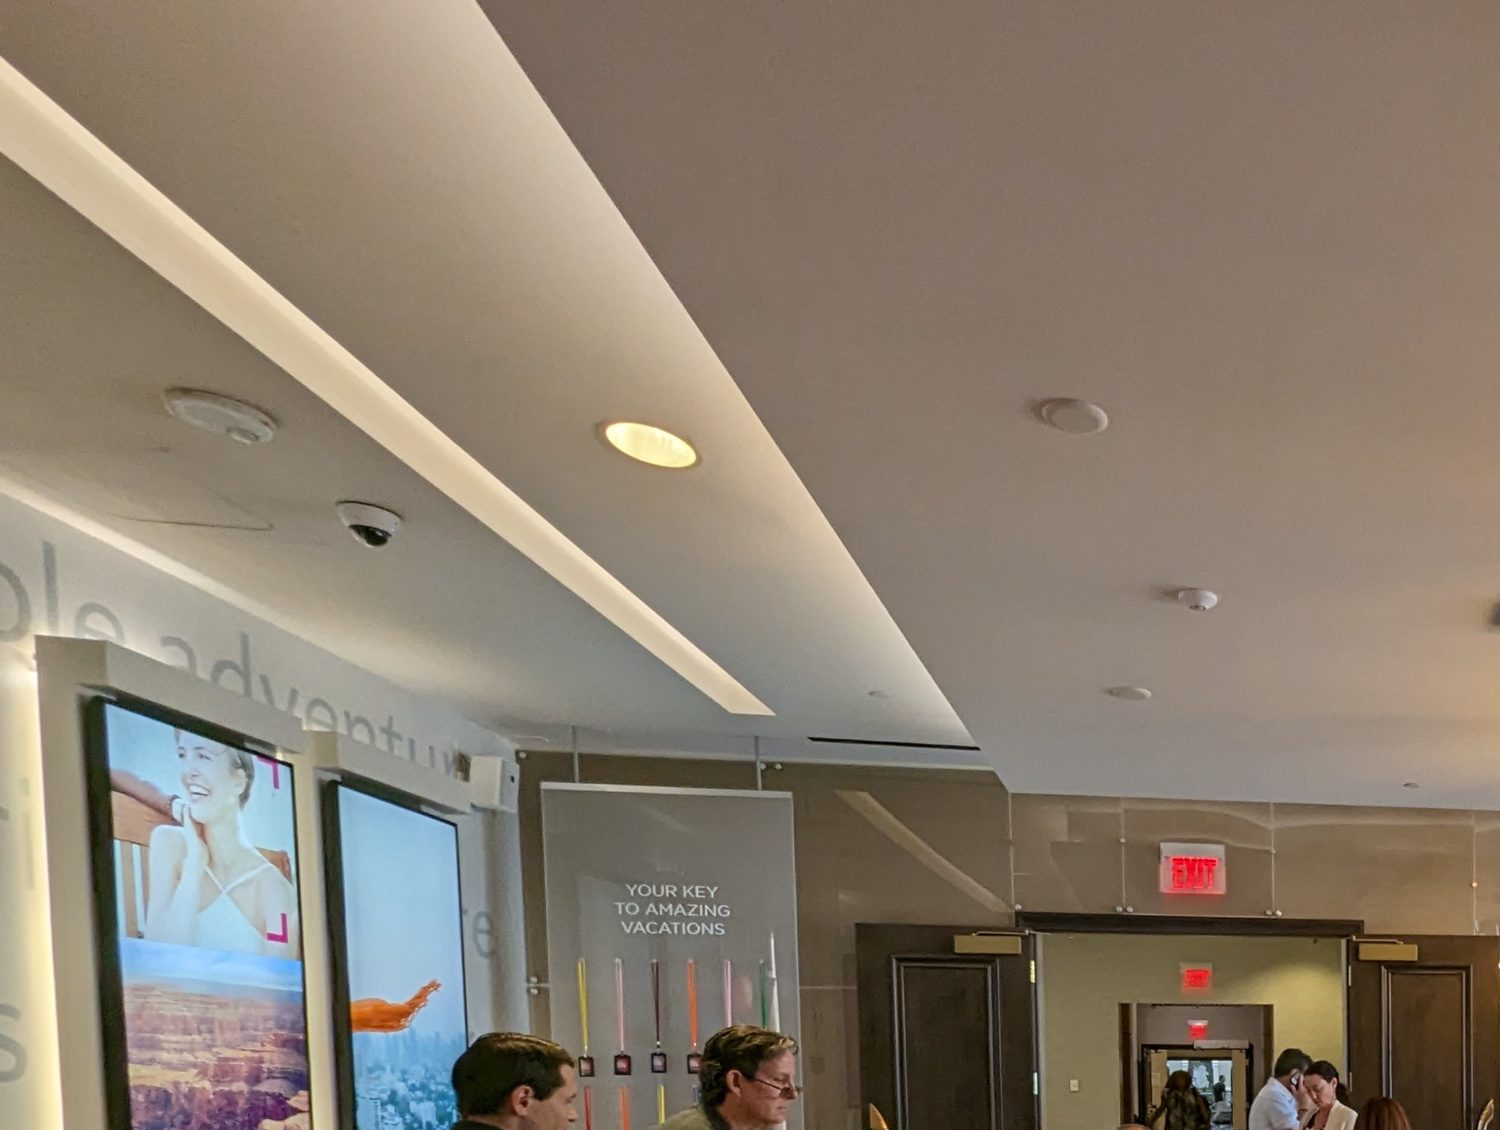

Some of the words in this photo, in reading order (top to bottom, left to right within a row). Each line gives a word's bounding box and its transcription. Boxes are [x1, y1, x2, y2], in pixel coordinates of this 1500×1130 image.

[1172, 857, 1218, 889] EXIT
[626, 883, 677, 898] YOUR
[683, 885, 719, 898] KEY
[614, 902, 640, 916] TO
[645, 902, 731, 917] AMAZING
[621, 920, 726, 936] VACATIONS
